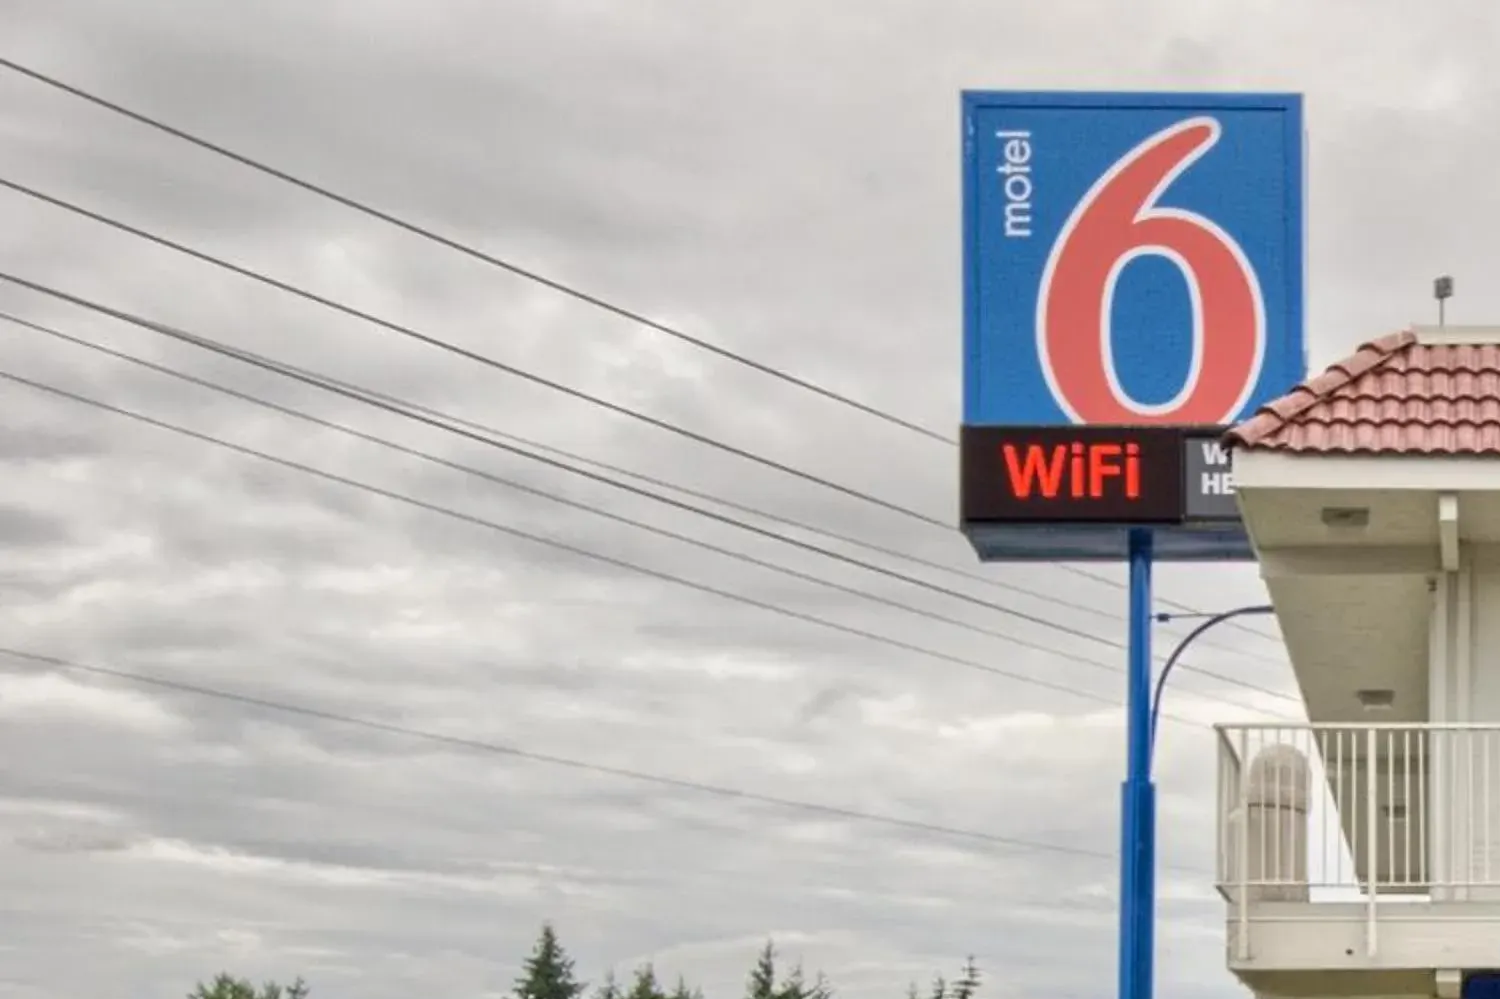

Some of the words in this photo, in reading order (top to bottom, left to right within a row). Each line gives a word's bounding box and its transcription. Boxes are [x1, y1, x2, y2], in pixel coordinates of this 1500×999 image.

[995, 130, 1032, 237] motel
[1036, 115, 1267, 425] 6
[1002, 441, 1141, 498] WiFi
